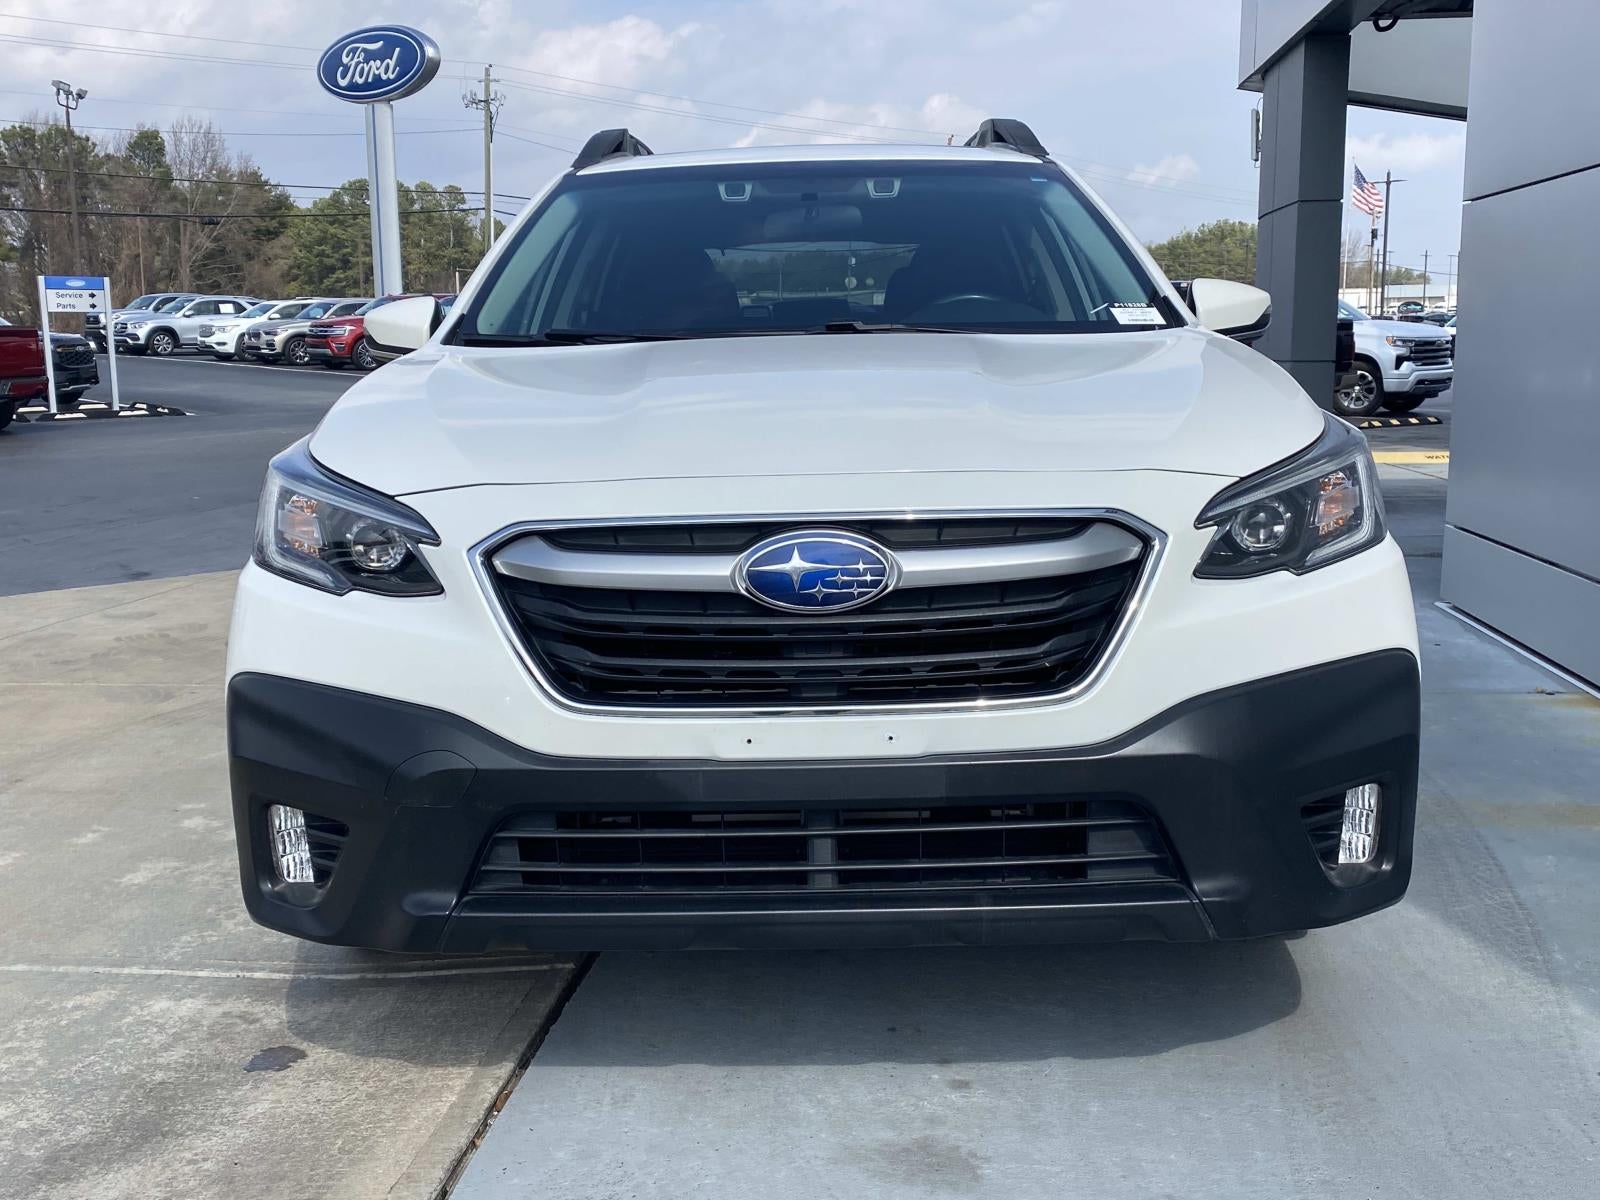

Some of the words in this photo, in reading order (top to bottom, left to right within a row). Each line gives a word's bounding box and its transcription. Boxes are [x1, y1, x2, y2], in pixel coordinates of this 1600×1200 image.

[337, 40, 400, 87] Ford
[55, 291, 84, 299] Service
[56, 302, 76, 310] Parts
